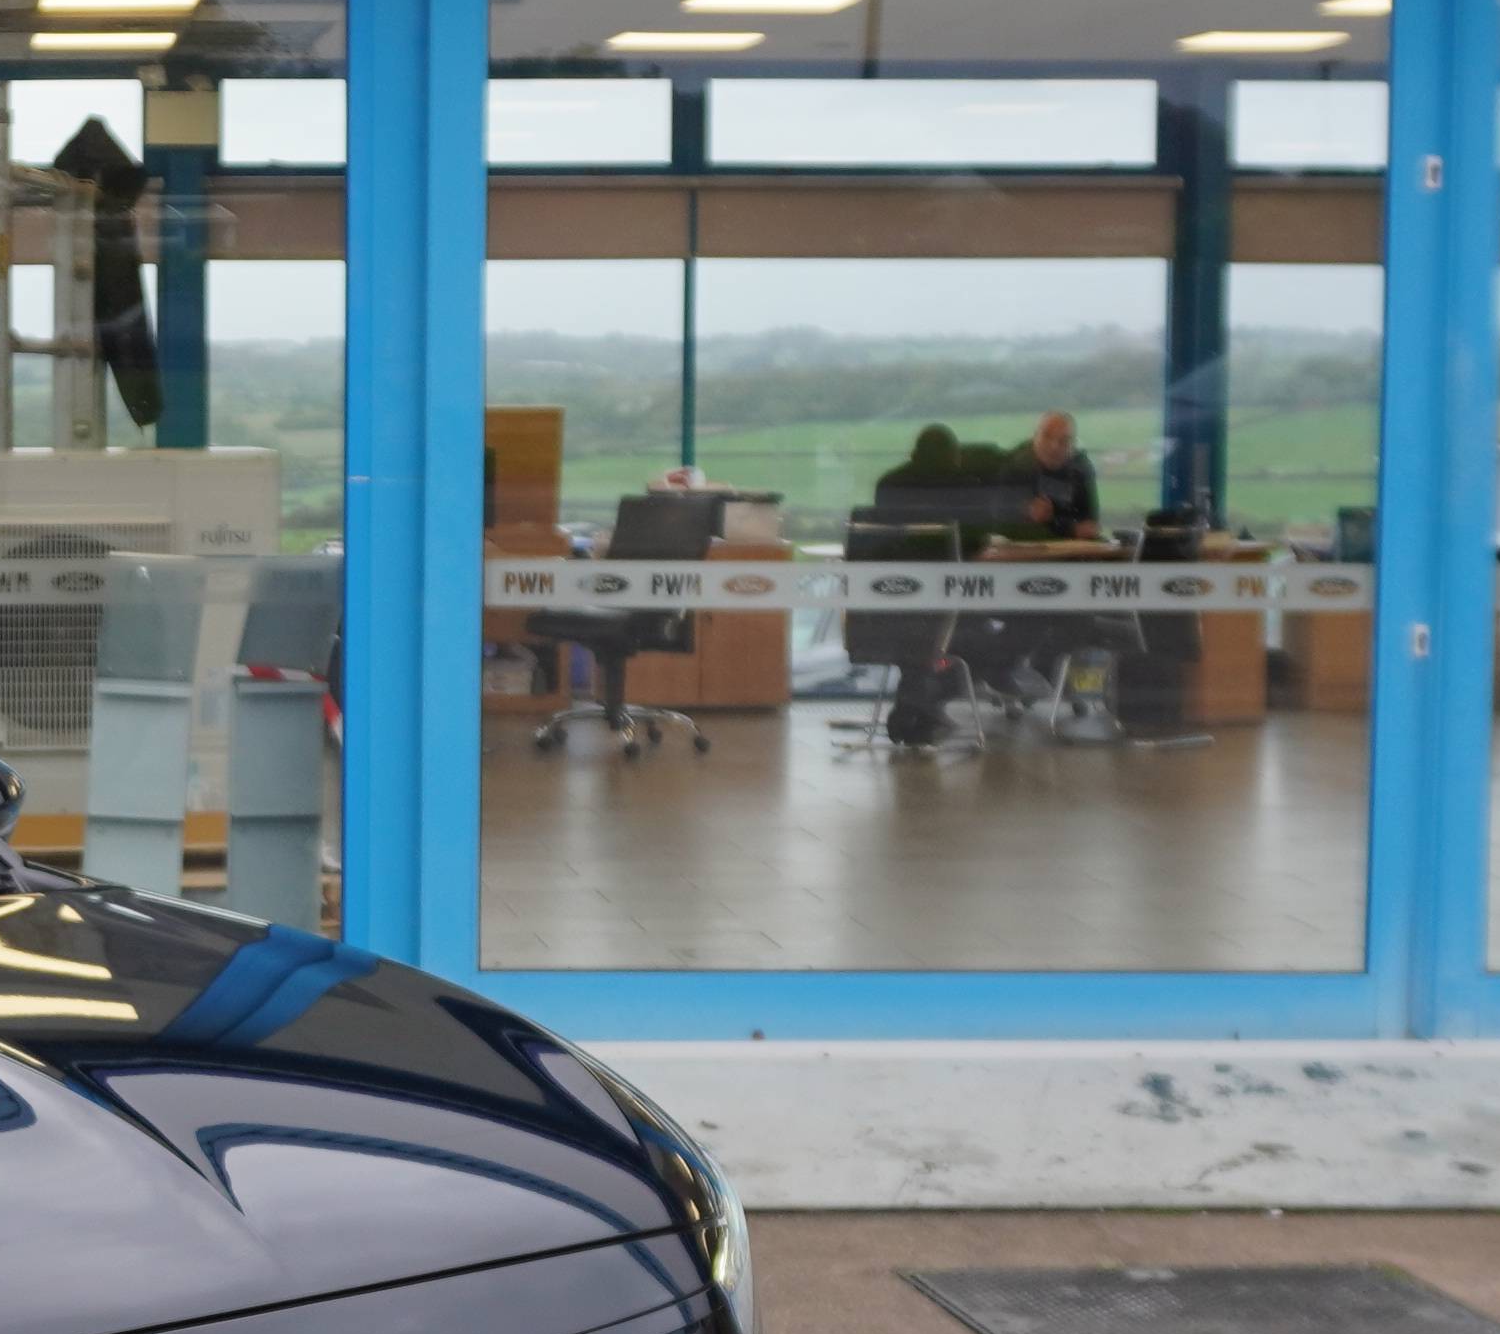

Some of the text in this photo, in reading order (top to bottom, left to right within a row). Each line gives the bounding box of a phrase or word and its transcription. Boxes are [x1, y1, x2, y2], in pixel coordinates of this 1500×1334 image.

[201, 521, 252, 546] FUJITSU
[504, 572, 555, 595] PWM
[651, 573, 702, 596] PWM
[944, 575, 995, 598] PWM
[1091, 575, 1141, 598] PWM
